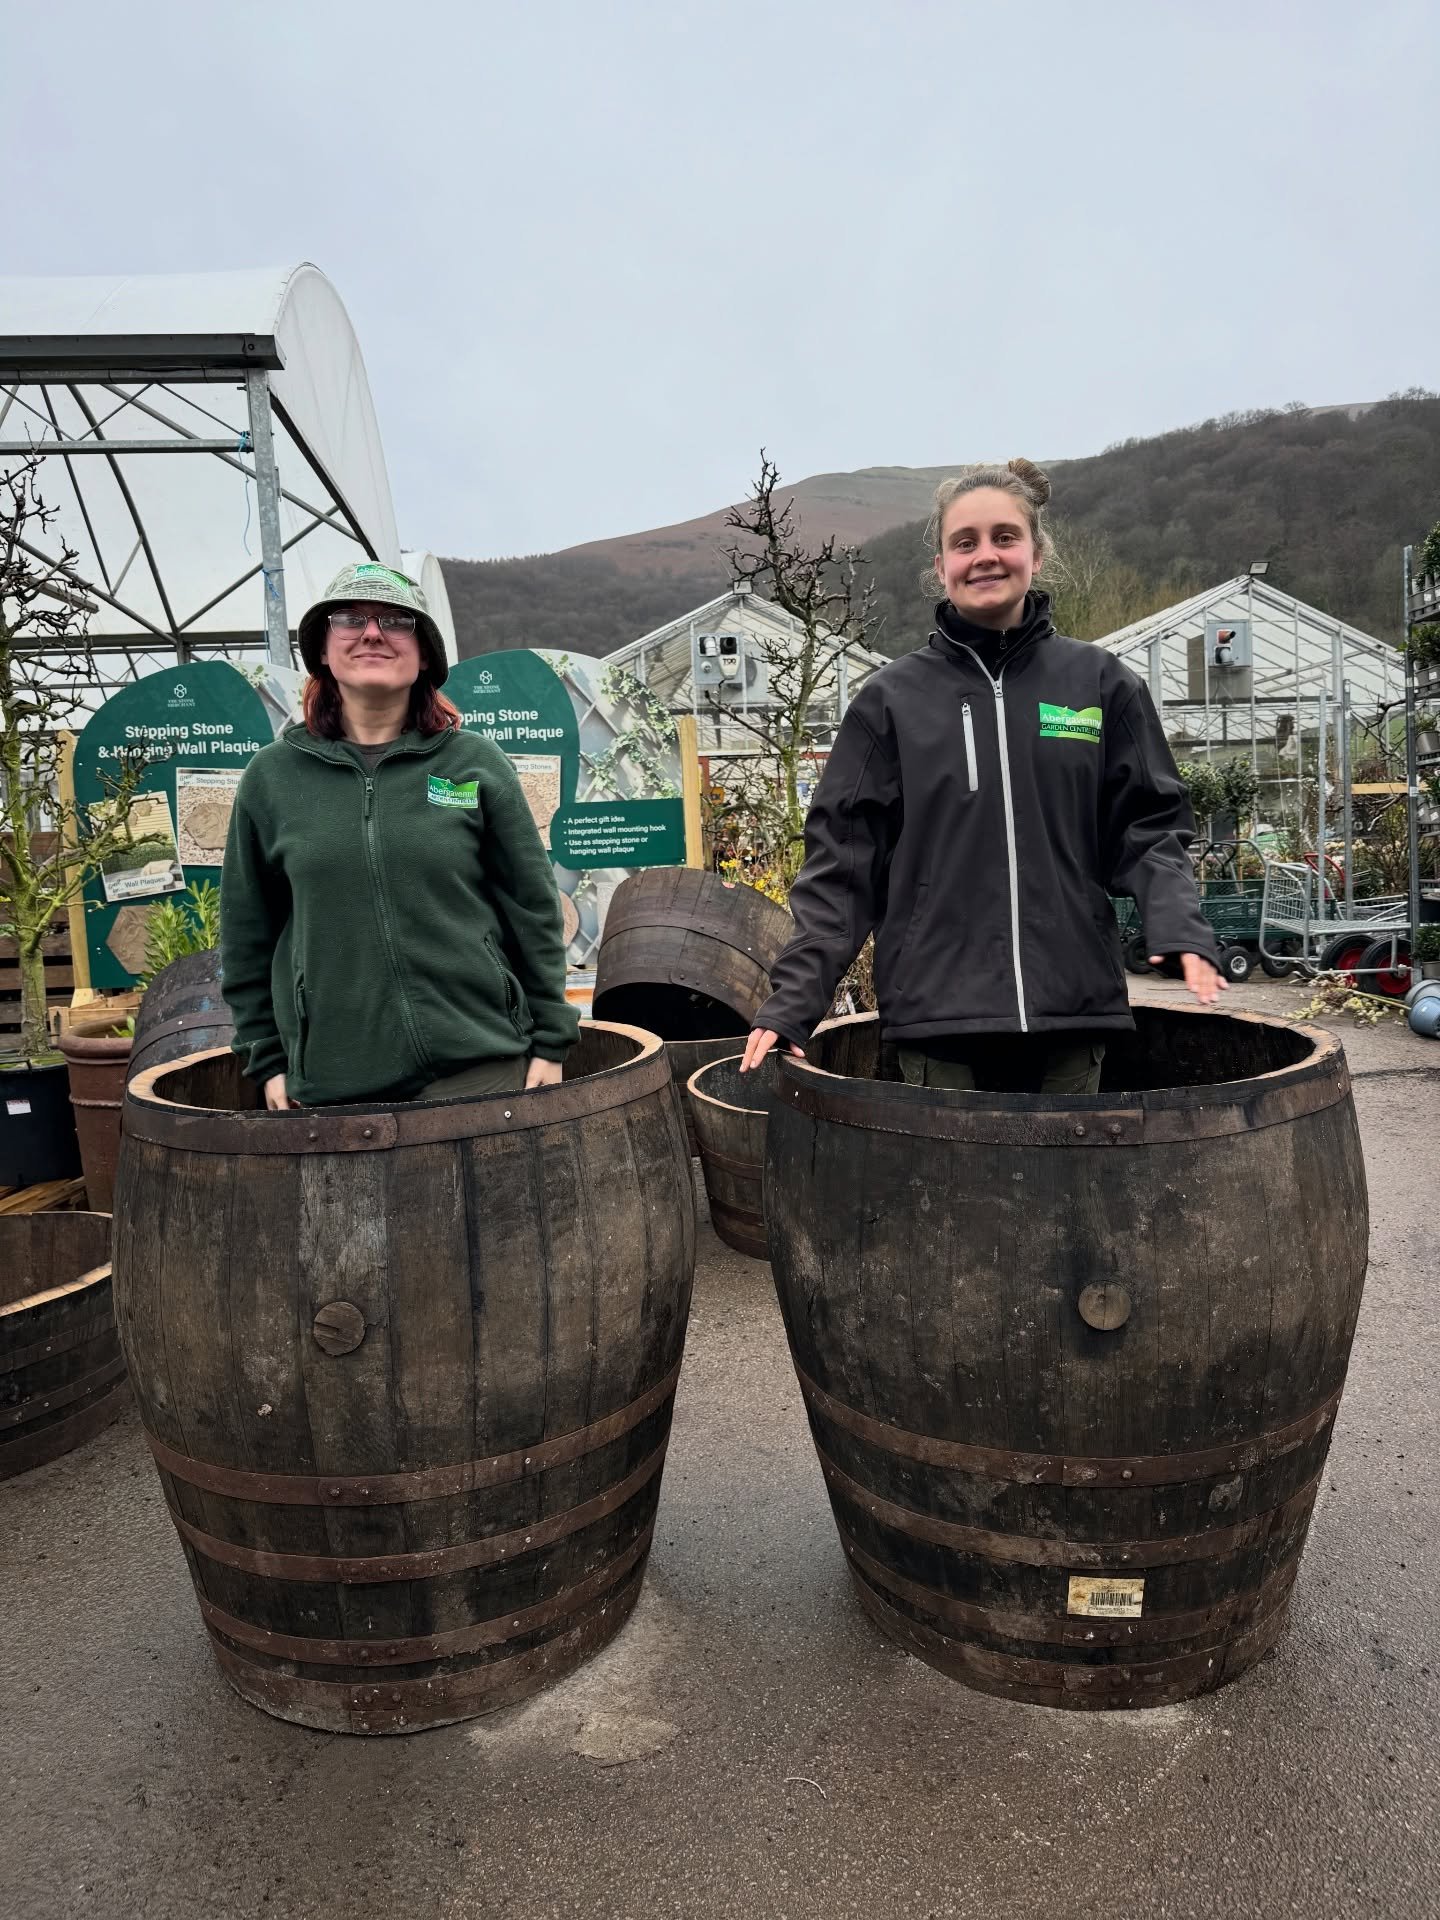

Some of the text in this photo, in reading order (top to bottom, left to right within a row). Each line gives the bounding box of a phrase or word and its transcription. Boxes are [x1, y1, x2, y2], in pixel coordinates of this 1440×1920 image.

[459, 709, 539, 726] pping Stone
[1042, 713, 1102, 730] Abergavenny
[125, 723, 234, 739] Stepping Stone
[483, 726, 564, 742] Wall Plaque
[1041, 723, 1069, 731] GARDEN
[1069, 725, 1091, 733] CENTRE
[98, 746, 111, 759] &
[176, 741, 207, 755] Wall
[211, 740, 261, 756] Plaque
[196, 777, 226, 786] Stepping
[429, 785, 476, 798] Abergavenny
[567, 815, 626, 826] A perfect gift idea
[568, 824, 667, 837] Integrated wall mounting hook
[568, 839, 582, 847] Use
[592, 837, 621, 847] stepping
[569, 845, 635, 856] hanging wall plaque
[124, 880, 139, 888] Wall
[140, 876, 166, 887] Plaques
